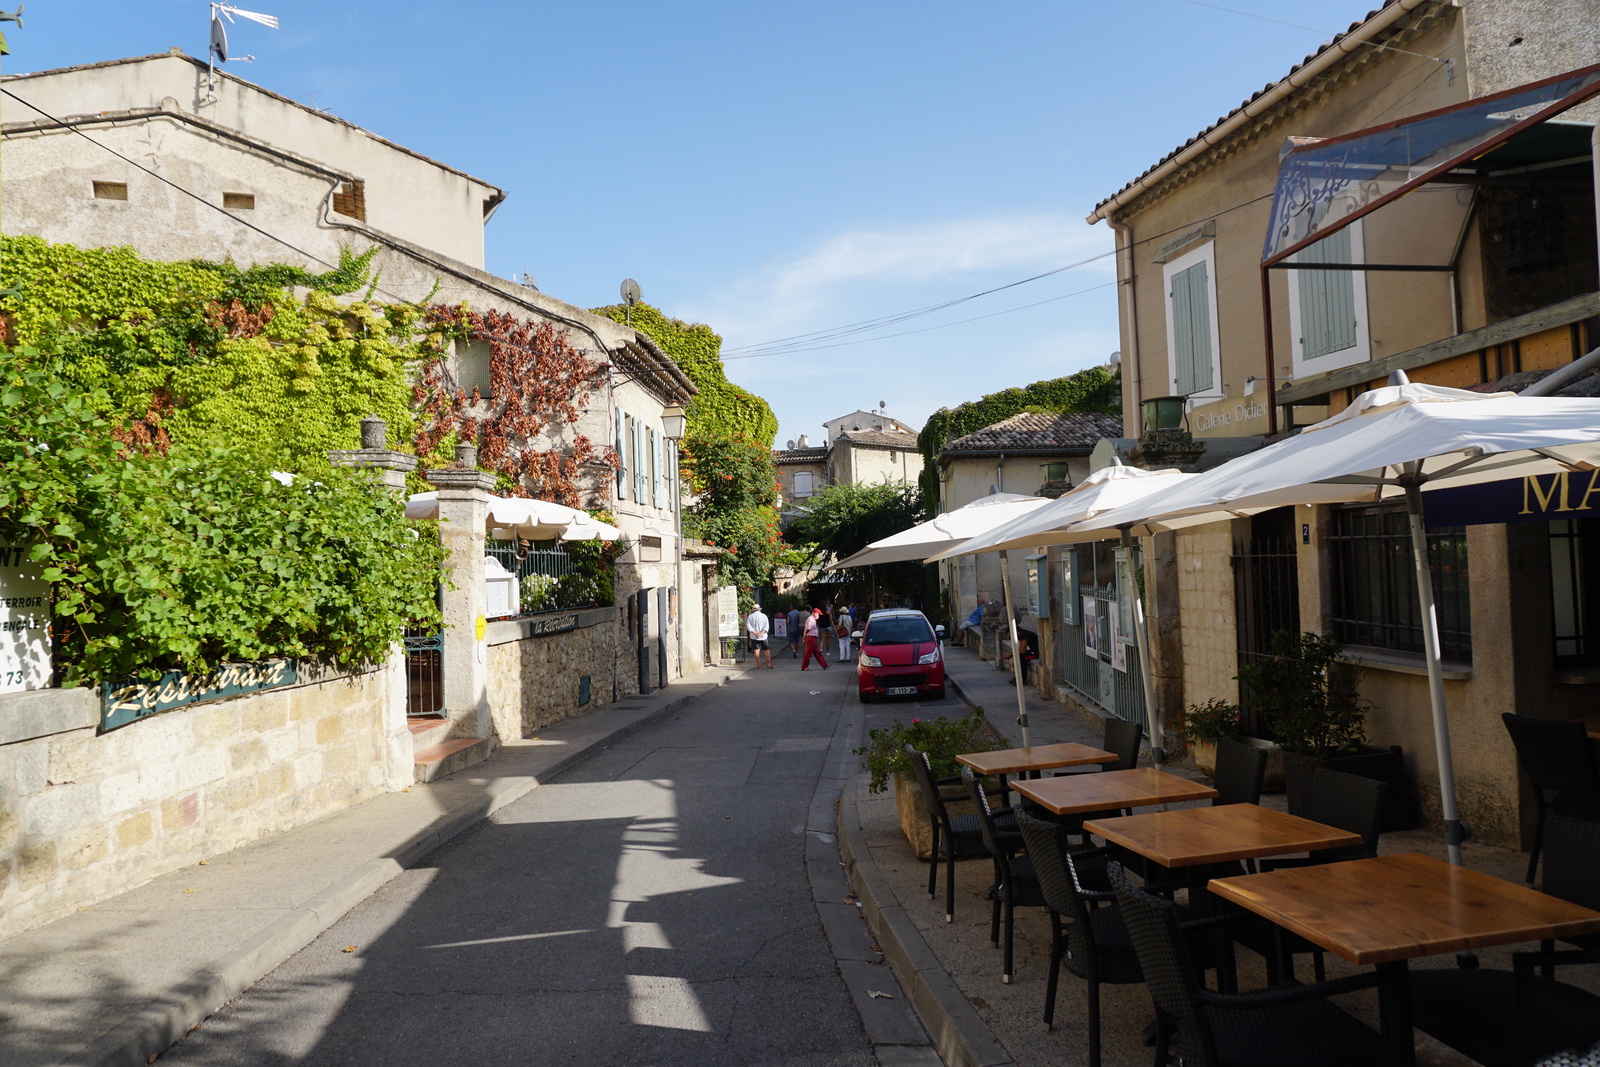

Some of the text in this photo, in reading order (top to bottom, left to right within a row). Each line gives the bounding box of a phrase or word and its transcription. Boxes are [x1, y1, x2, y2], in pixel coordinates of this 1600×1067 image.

[1197, 409, 1232, 431] Galerie
[1235, 400, 1268, 422] Didier
[1303, 525, 1308, 536] 2
[0, 596, 42, 609] TERROIR
[107, 660, 287, 718] Restaurant
